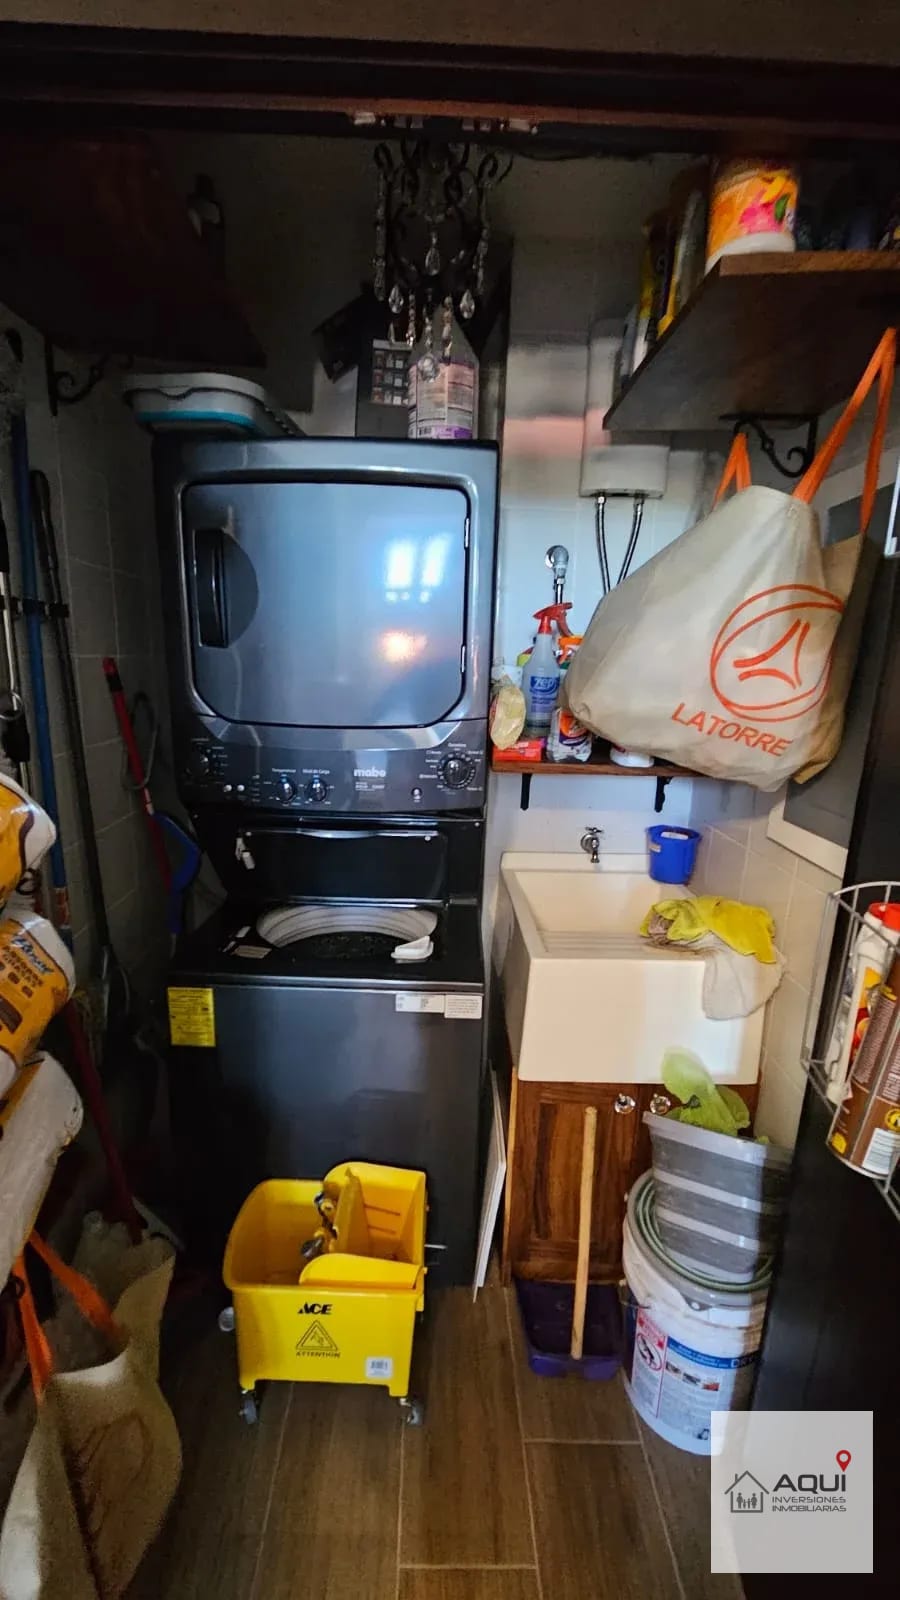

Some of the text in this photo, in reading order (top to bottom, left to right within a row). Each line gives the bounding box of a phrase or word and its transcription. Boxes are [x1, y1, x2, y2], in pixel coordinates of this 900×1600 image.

[671, 702, 793, 757] LATORRE
[353, 766, 386, 777] mabe
[297, 1302, 333, 1315] ACE
